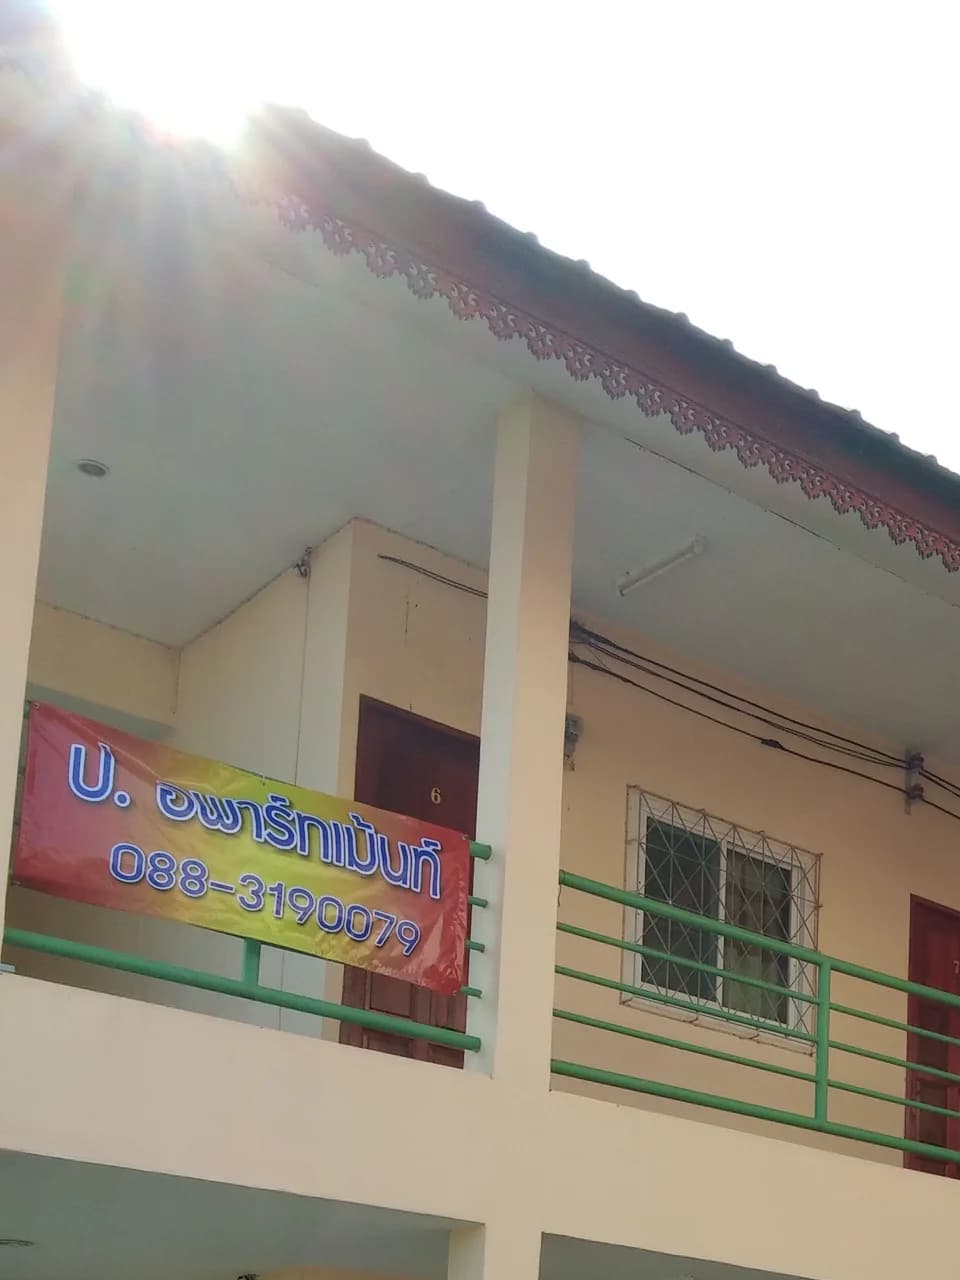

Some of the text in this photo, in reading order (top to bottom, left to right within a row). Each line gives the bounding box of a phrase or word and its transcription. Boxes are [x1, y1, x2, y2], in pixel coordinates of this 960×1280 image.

[68, 742, 441, 899] ป. อพาร์ทเม้นท์
[431, 787, 441, 804] 6
[110, 843, 420, 956] 088-3190079
[953, 960, 960, 974] 7
